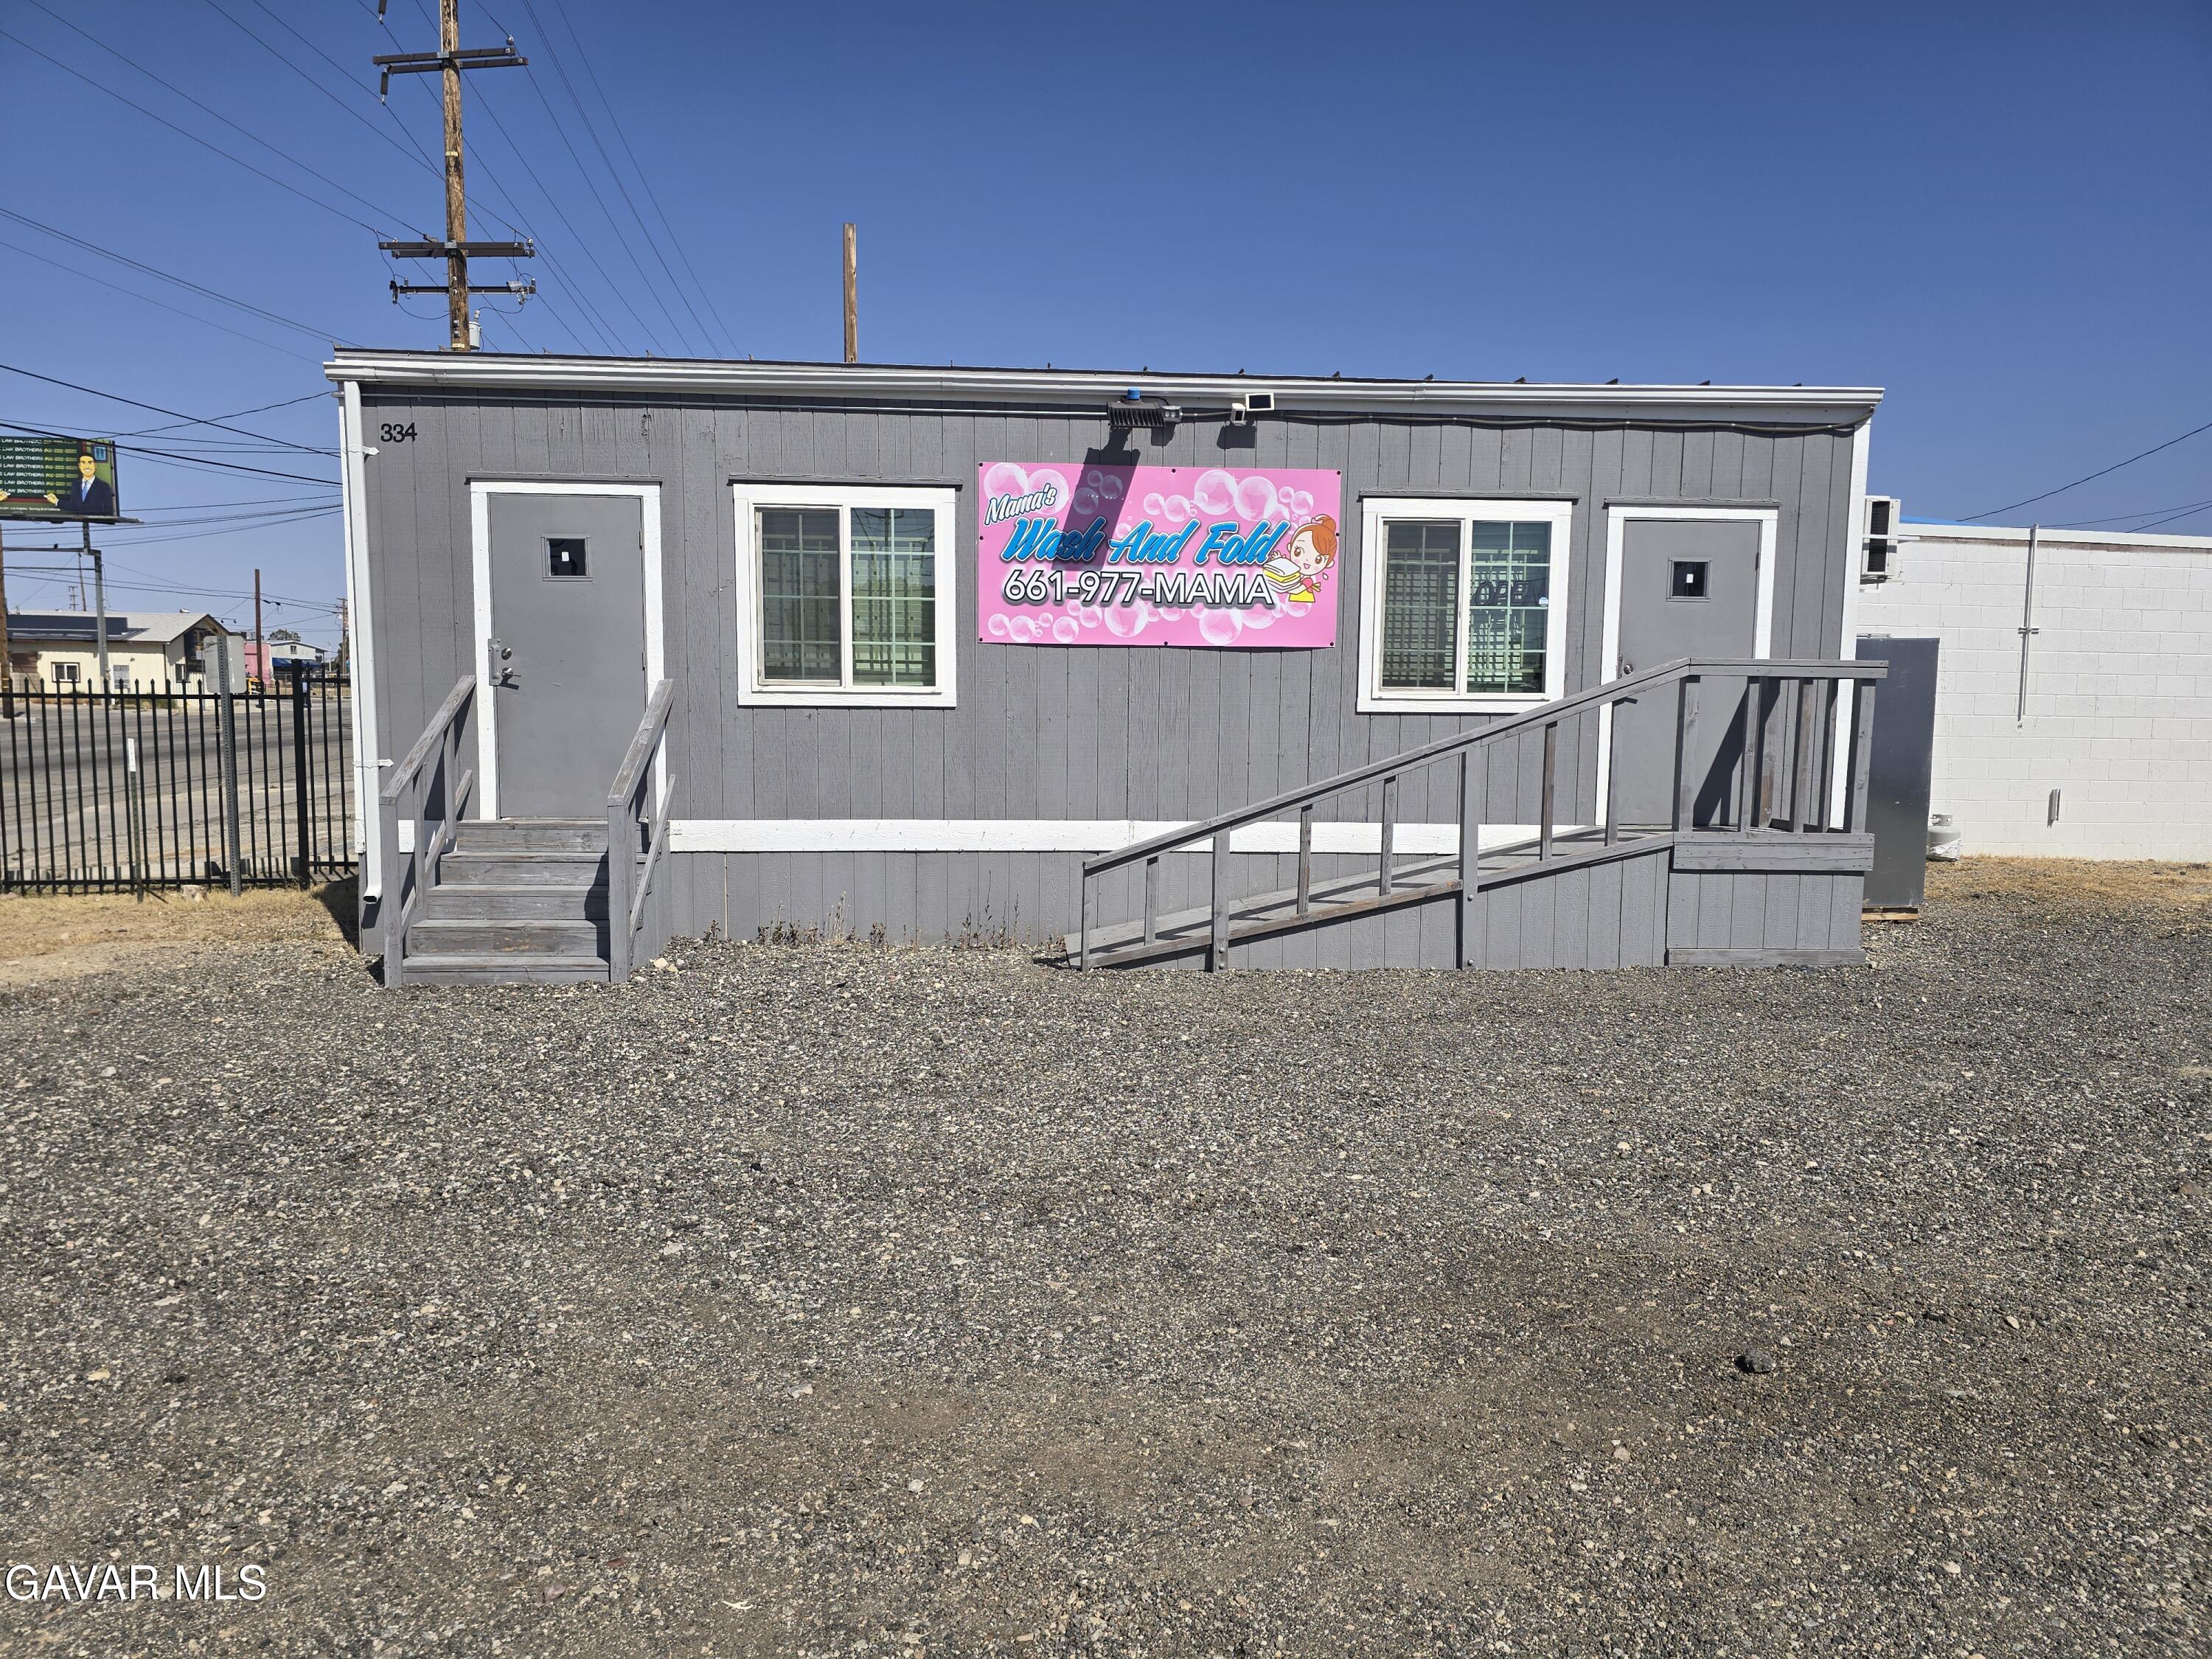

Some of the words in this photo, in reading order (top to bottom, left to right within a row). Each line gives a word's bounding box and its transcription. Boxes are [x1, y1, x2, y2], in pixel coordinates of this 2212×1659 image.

[380, 422, 417, 442] 334
[984, 483, 1057, 526] Mama's
[1001, 516, 1107, 562] Wash
[1108, 518, 1200, 564] And
[1194, 519, 1290, 565] Fold
[1004, 569, 1275, 605] 661-977-MAMA
